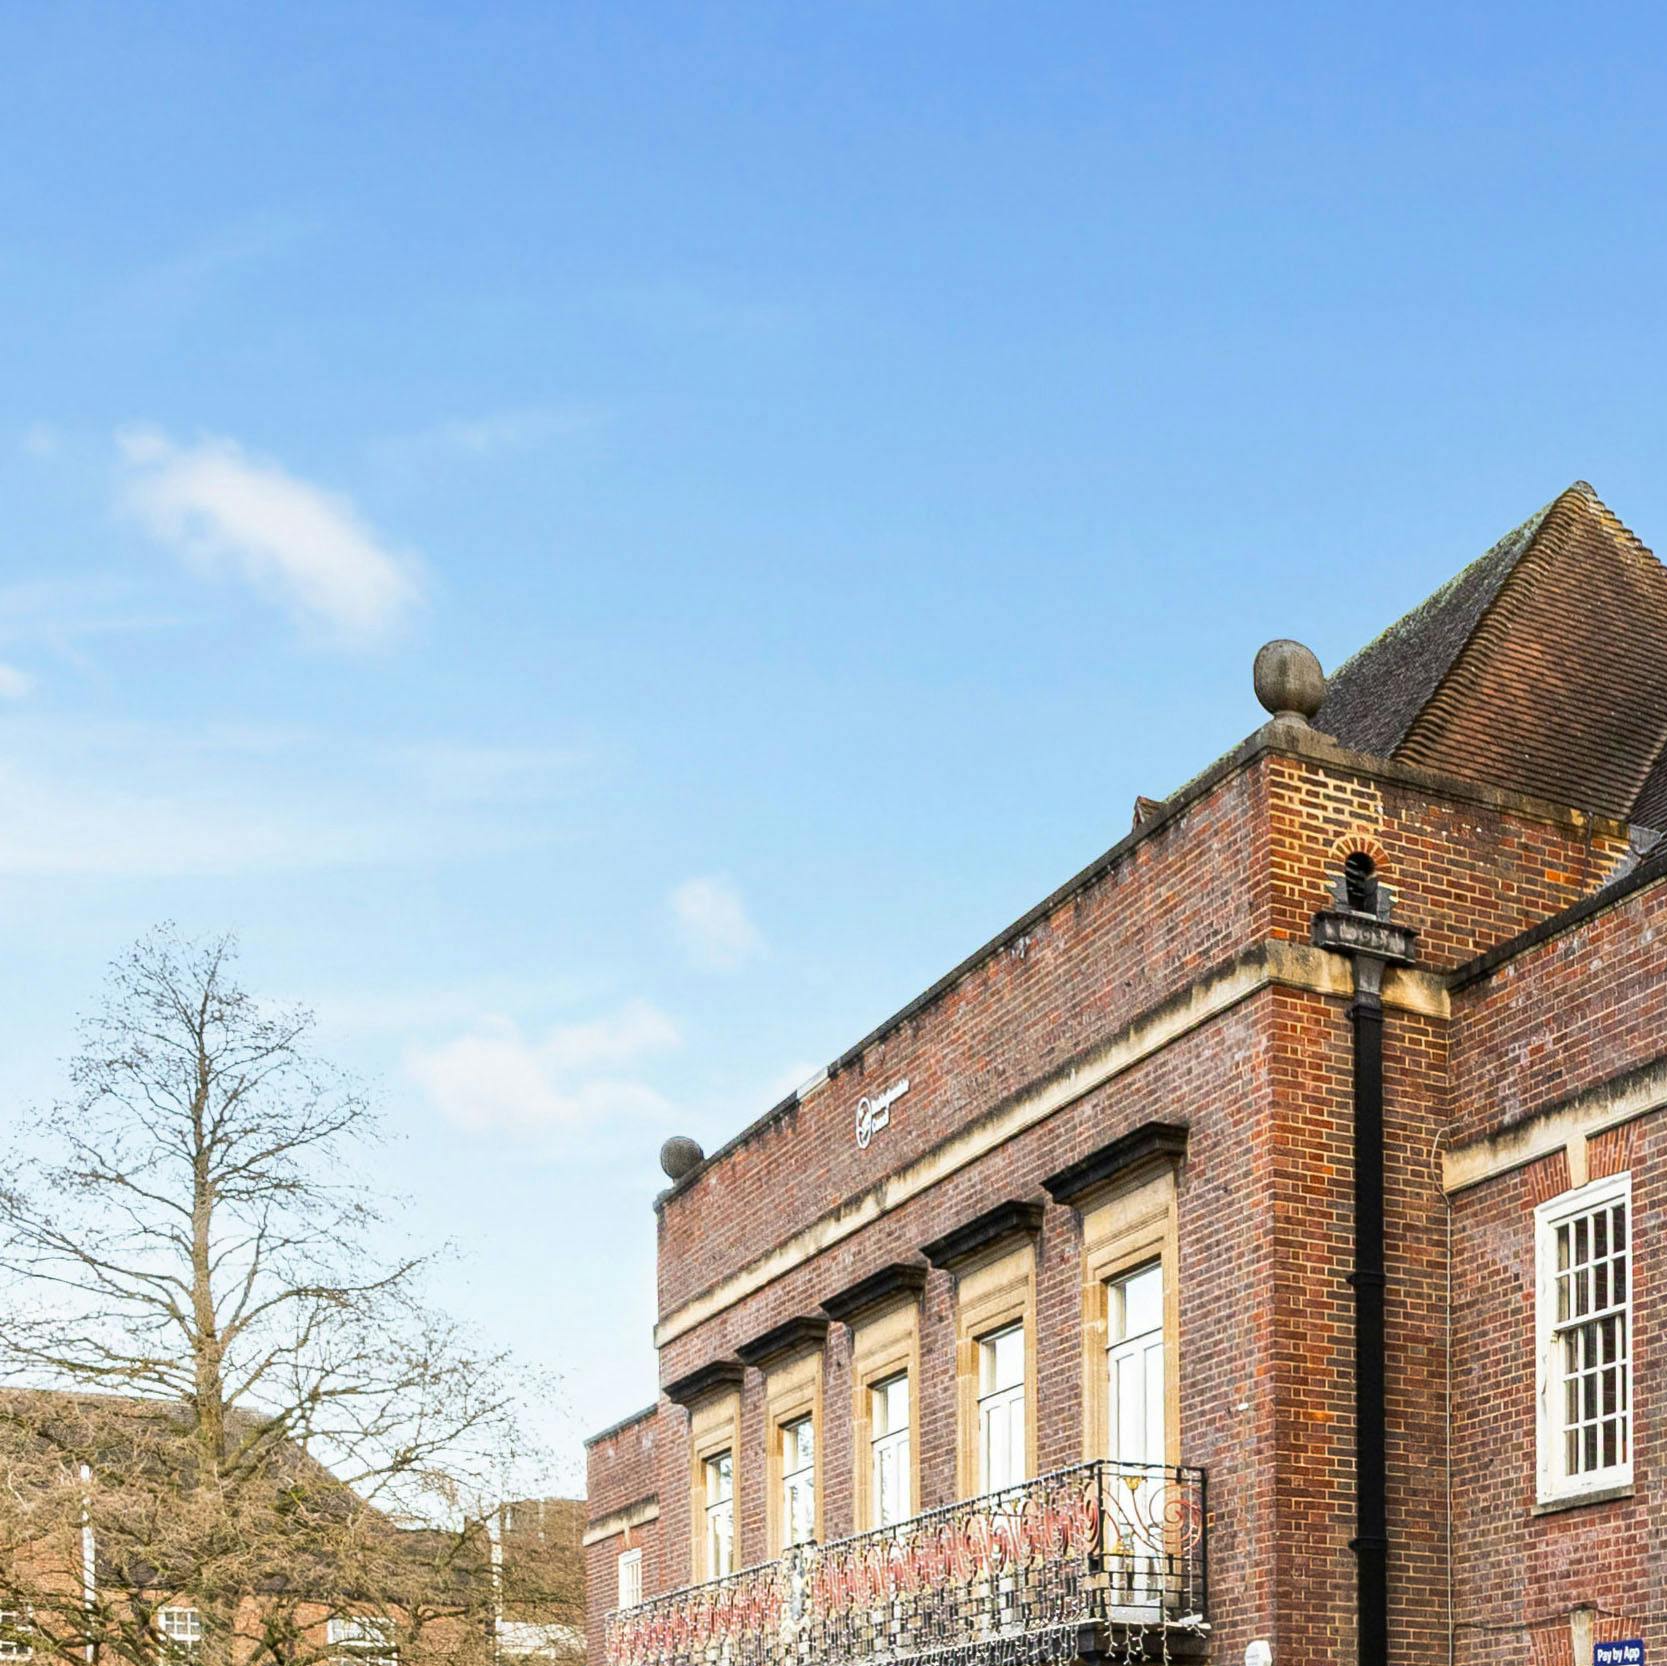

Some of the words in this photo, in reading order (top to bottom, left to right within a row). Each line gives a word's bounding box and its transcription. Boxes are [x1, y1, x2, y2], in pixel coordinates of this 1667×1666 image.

[1597, 1649, 1612, 1664] Pay
[1612, 1647, 1623, 1663] by
[1623, 1645, 1640, 1662] App
